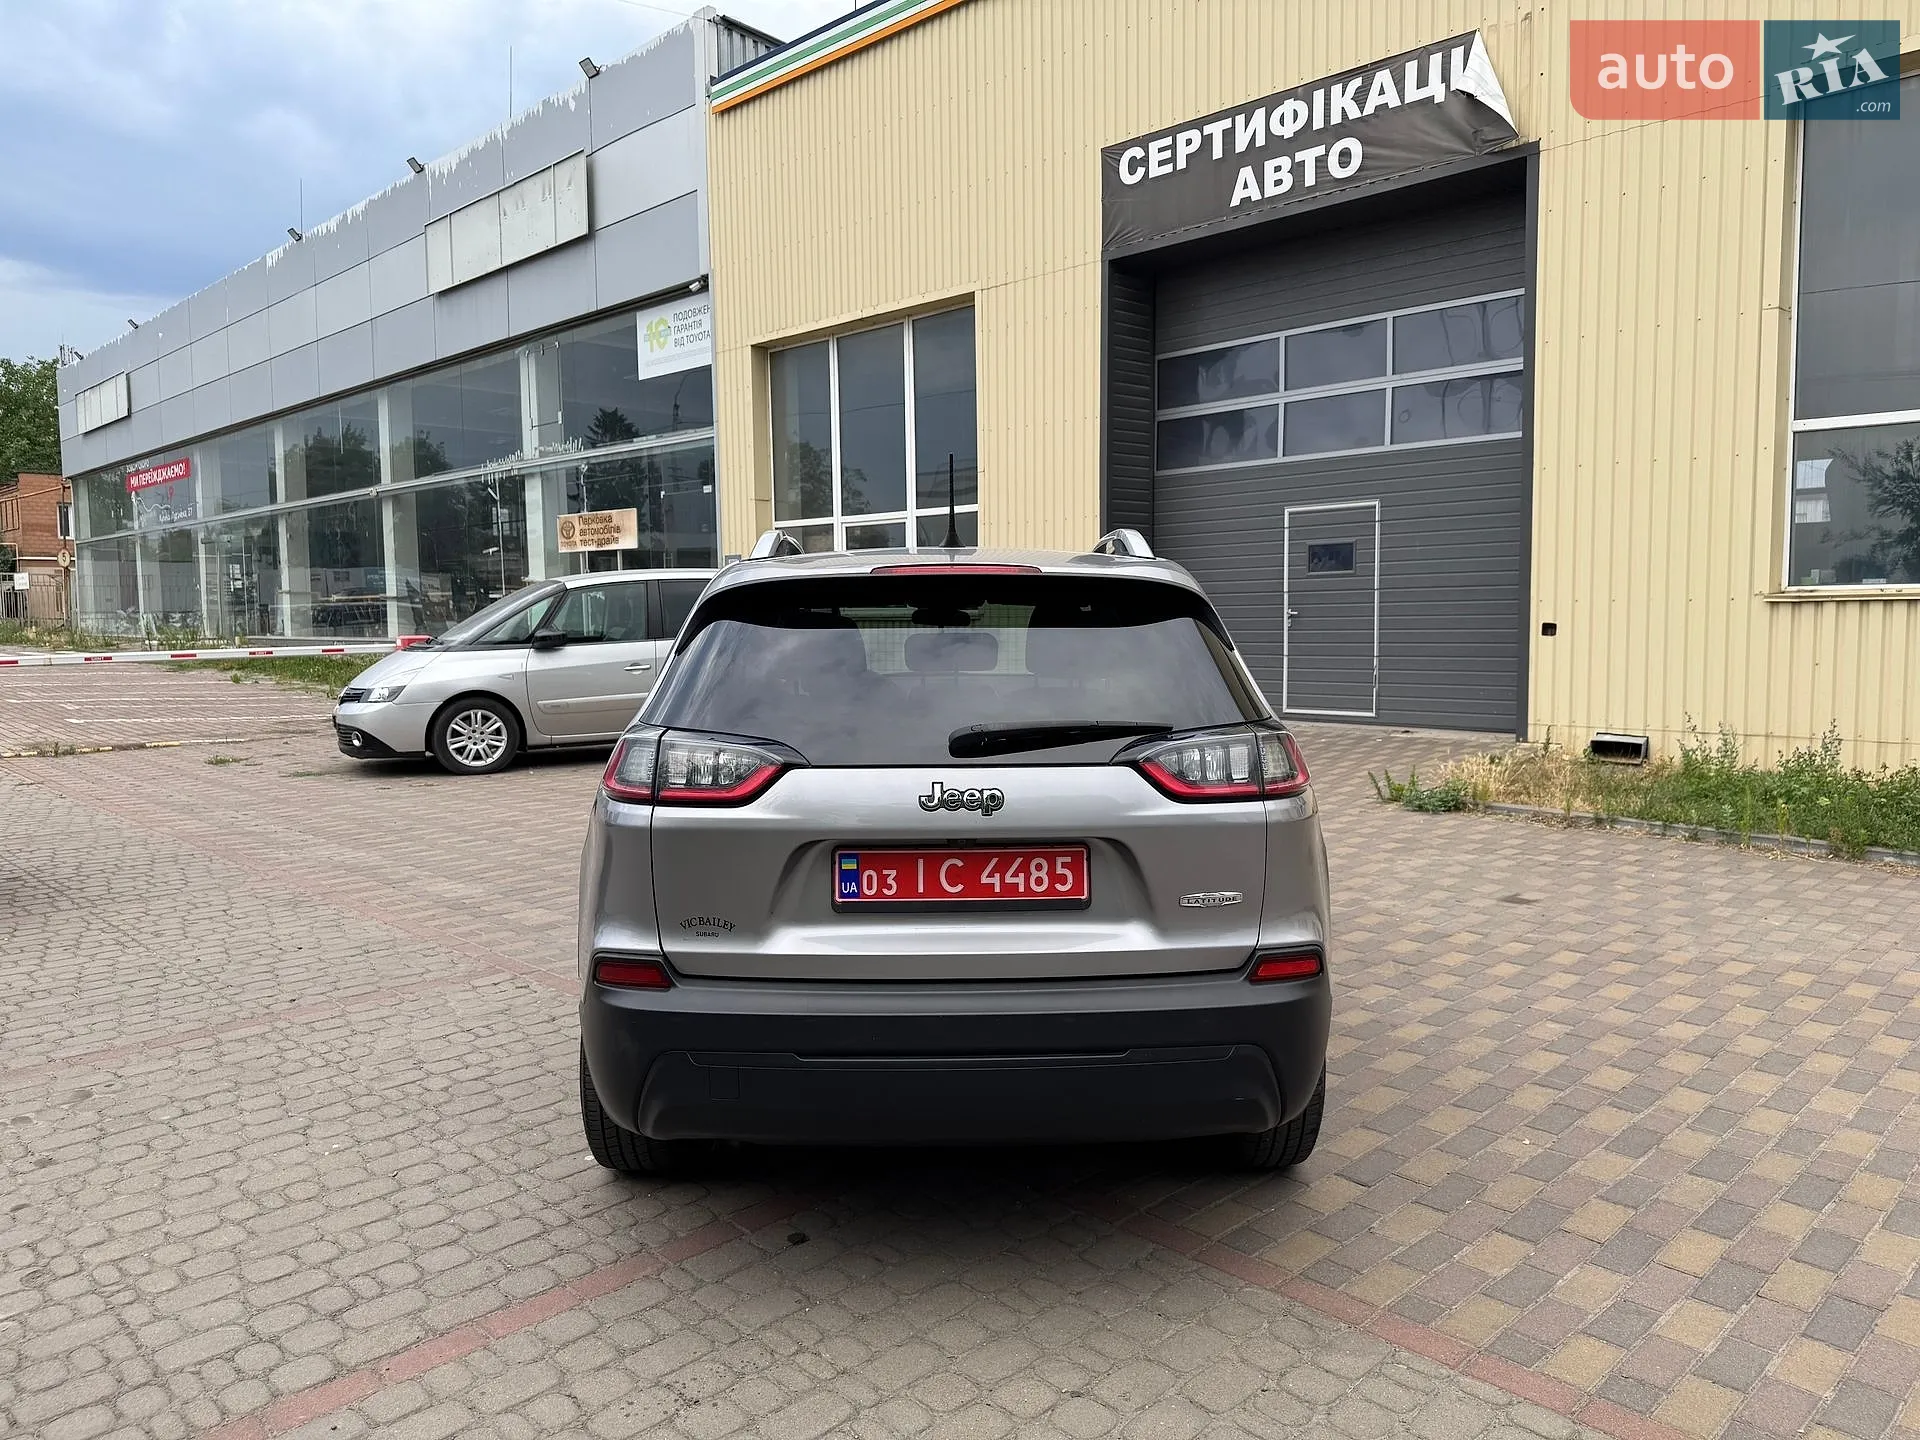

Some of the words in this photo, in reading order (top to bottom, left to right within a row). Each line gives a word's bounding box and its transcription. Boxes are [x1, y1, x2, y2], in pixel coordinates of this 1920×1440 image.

[1229, 137, 1364, 208] АВТО
[673, 319, 702, 335] ГАРАНТІЯ
[673, 336, 685, 348] ВІД
[686, 330, 711, 345] TOYOTA
[578, 514, 613, 527] Парковка
[580, 524, 621, 537] автомобілів
[580, 535, 620, 548] тест-драйв
[919, 781, 1004, 816] Jeep
[862, 869, 898, 896] 03
[980, 856, 1073, 893] 4485
[841, 882, 858, 893] UA
